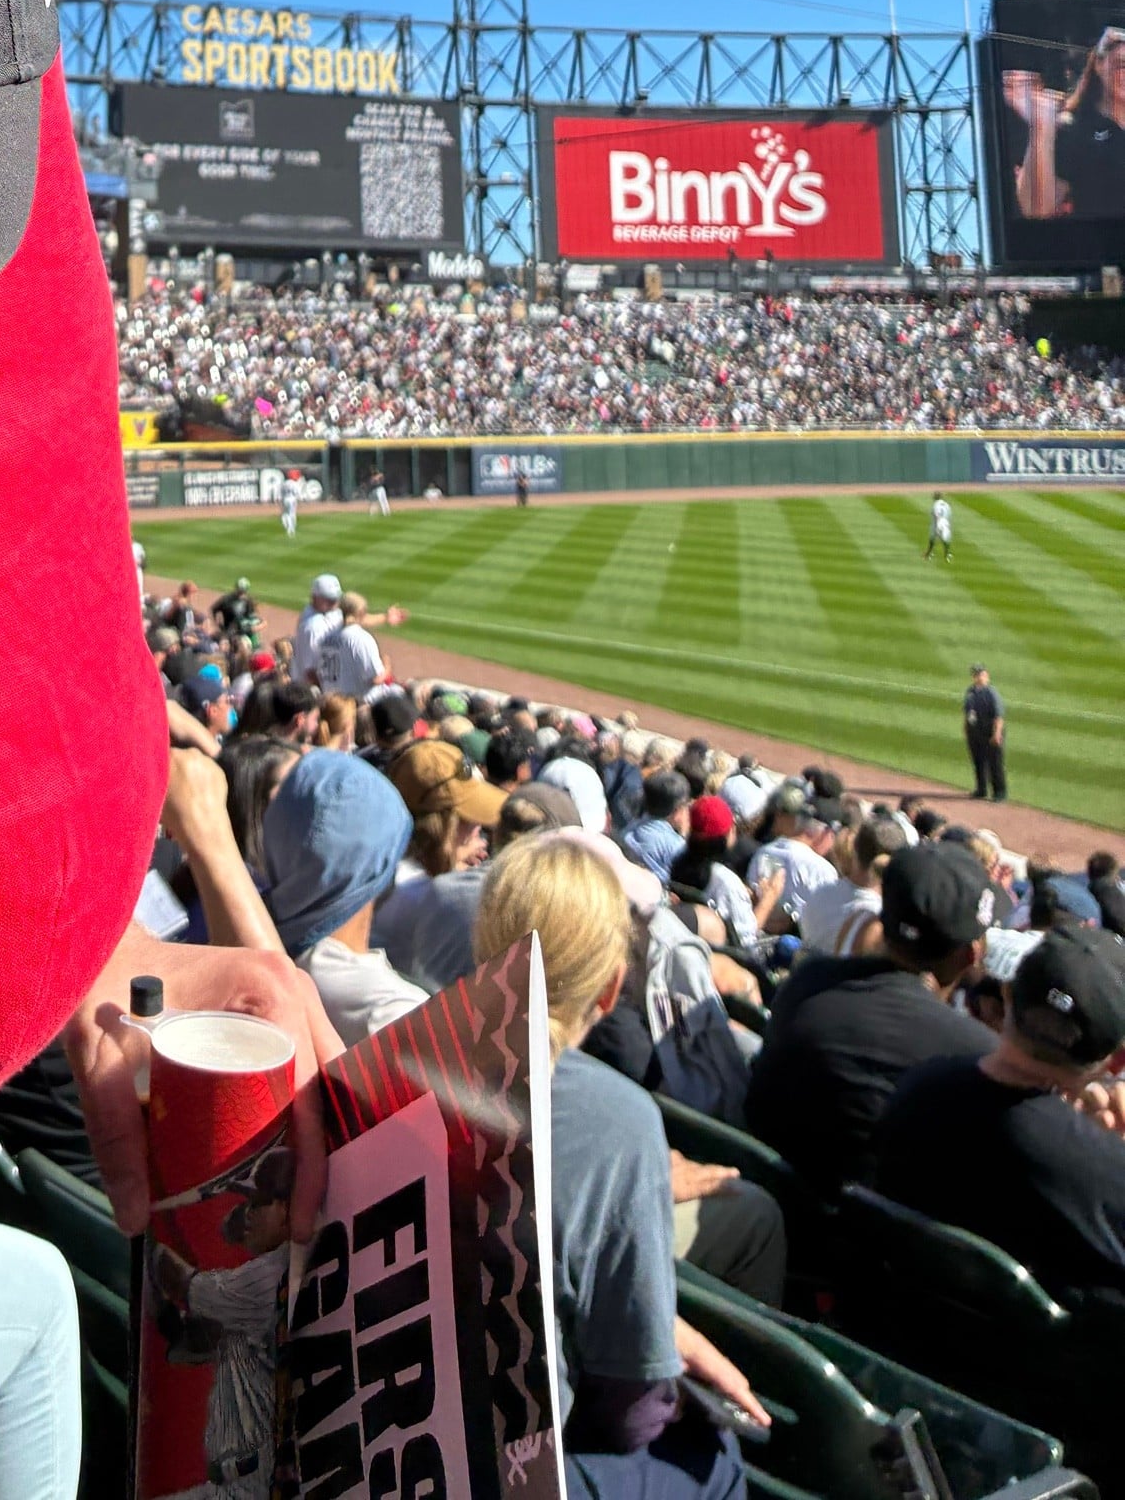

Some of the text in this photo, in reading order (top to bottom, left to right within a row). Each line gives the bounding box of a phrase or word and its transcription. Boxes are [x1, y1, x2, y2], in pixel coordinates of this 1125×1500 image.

[182, 4, 312, 39] CAESARS
[181, 38, 400, 95] SPORTSBOOK
[613, 224, 741, 244] BEVERAGE DEPOT
[428, 251, 485, 278] Modelo
